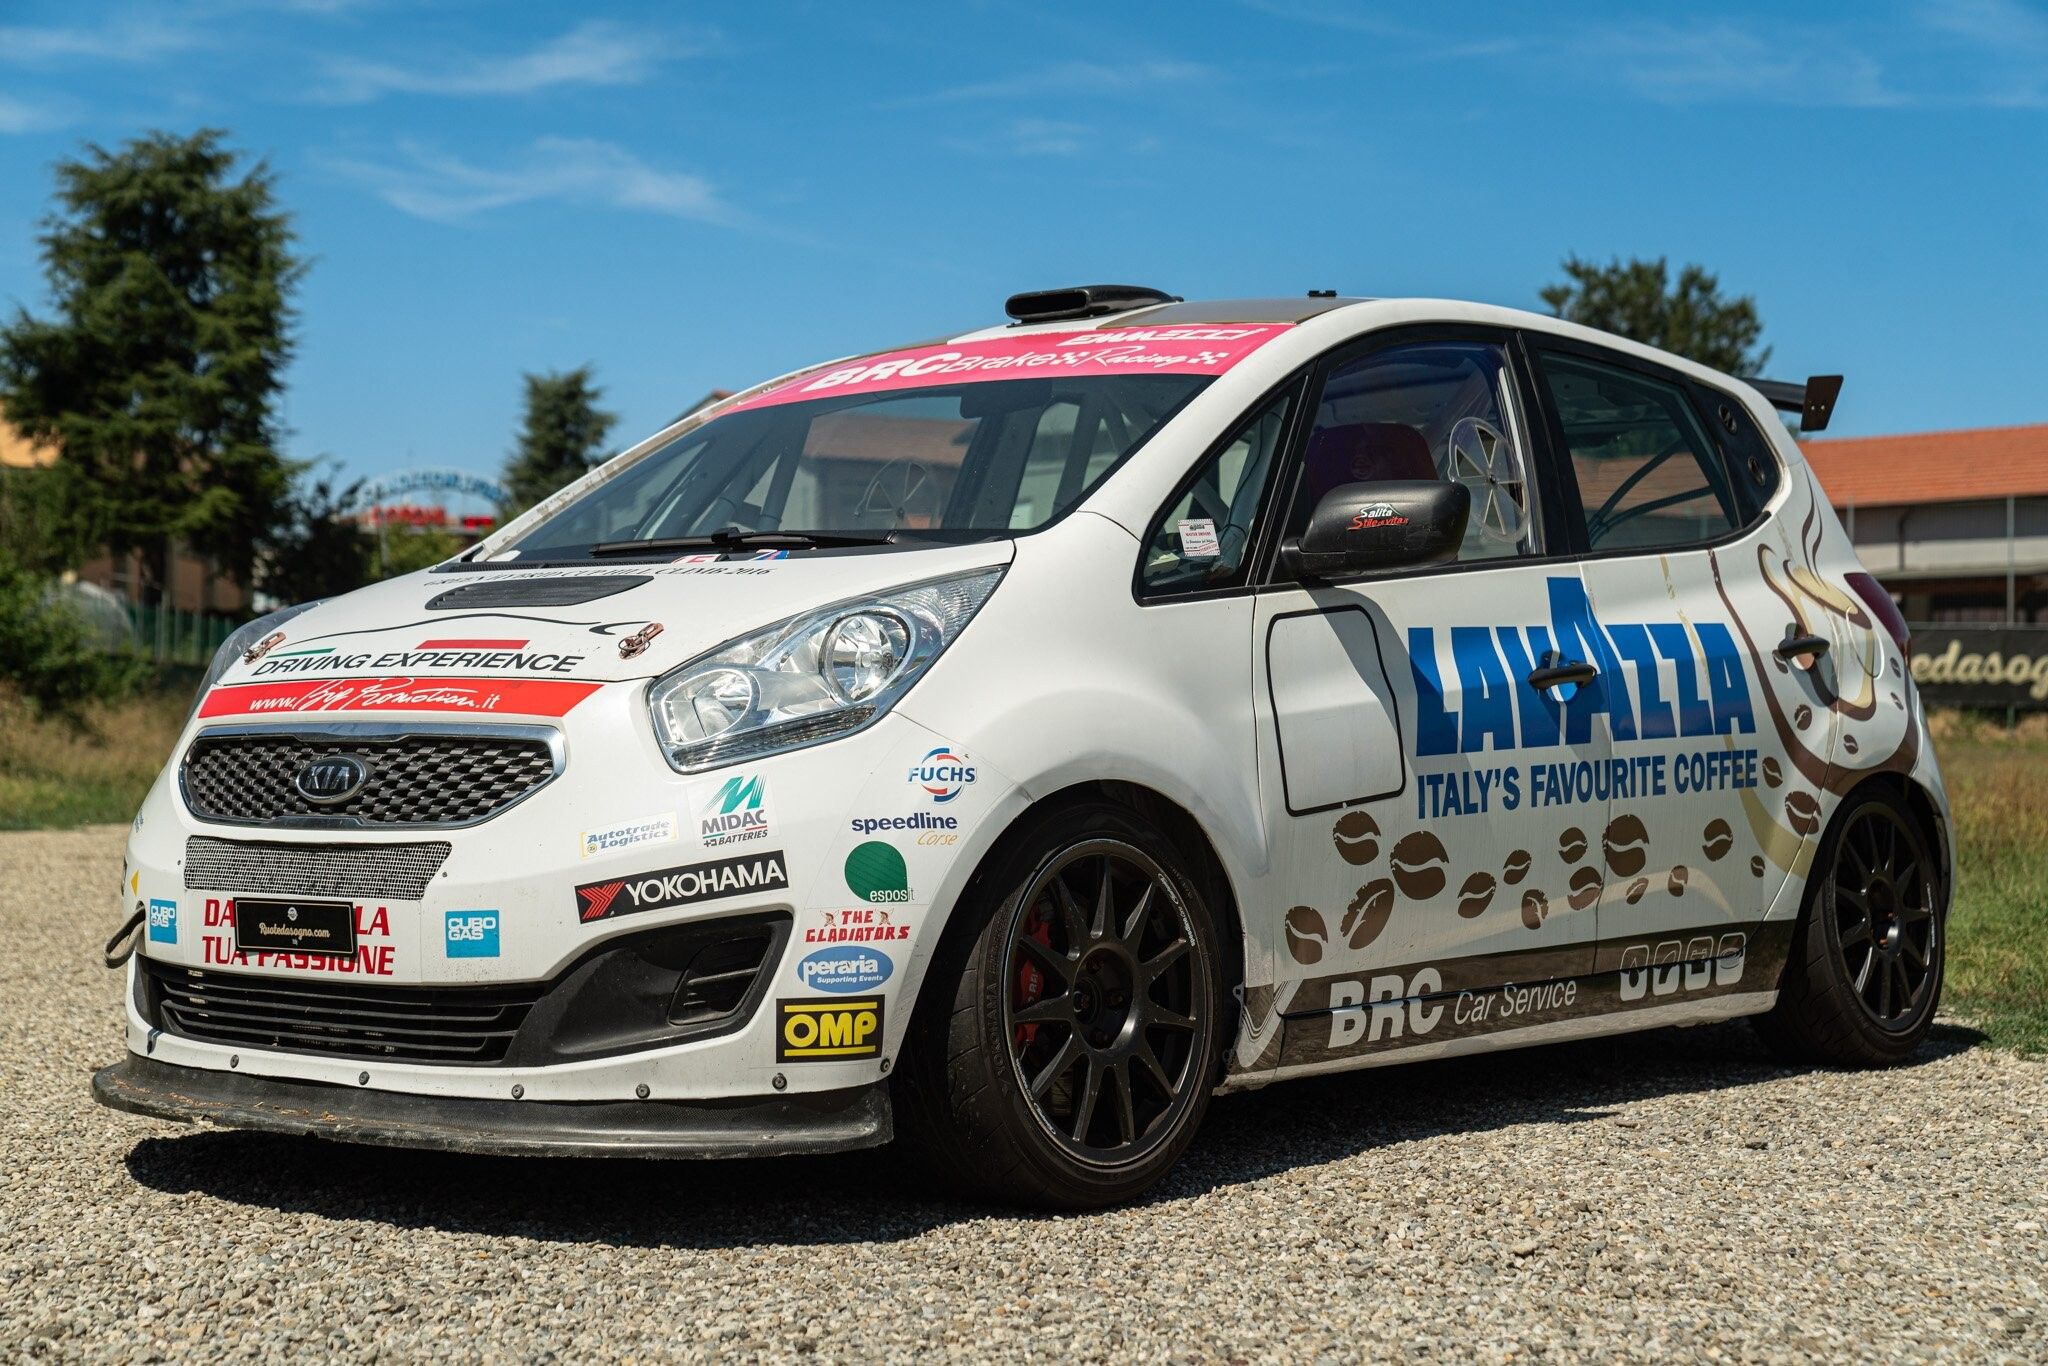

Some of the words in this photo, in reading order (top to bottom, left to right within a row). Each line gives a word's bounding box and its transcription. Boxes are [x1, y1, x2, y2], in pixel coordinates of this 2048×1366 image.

[799, 352, 962, 392] BRC
[939, 351, 1053, 373] Brake
[1072, 345, 1187, 368] Racing
[1360, 507, 1393, 518] Salita
[251, 653, 372, 677] DRIVING
[369, 651, 586, 673] EXPERIENCE
[1407, 576, 1757, 757] LAVAZZA
[304, 765, 351, 790] KIA
[908, 766, 976, 783] FUCHS
[1417, 765, 1521, 820] ITALY'S
[1530, 755, 1667, 808] FAVOURITE
[1674, 748, 1759, 793] COFFEE
[587, 819, 670, 845] Autotrade
[702, 809, 767, 835] MIDAC
[851, 812, 958, 835] speedline
[600, 829, 669, 850] Logistics
[718, 829, 768, 845] BATTERIES
[917, 830, 958, 846] Corse
[624, 859, 786, 906] YOKOHAMA
[150, 905, 175, 919] CUBO
[150, 914, 169, 928] GAS
[841, 910, 874, 925] THE
[259, 922, 331, 941] Ruotedasogno.com
[448, 916, 497, 930] CUBO
[448, 928, 484, 941] GAS
[804, 926, 911, 943] GLADIATORS
[803, 954, 879, 986] peraria
[817, 976, 857, 986] Supporting
[859, 974, 883, 982] Events
[1328, 967, 1445, 1049] BRC
[1454, 989, 1497, 1025] Car
[1500, 976, 1578, 1018] Service
[784, 1010, 877, 1048] OMP
